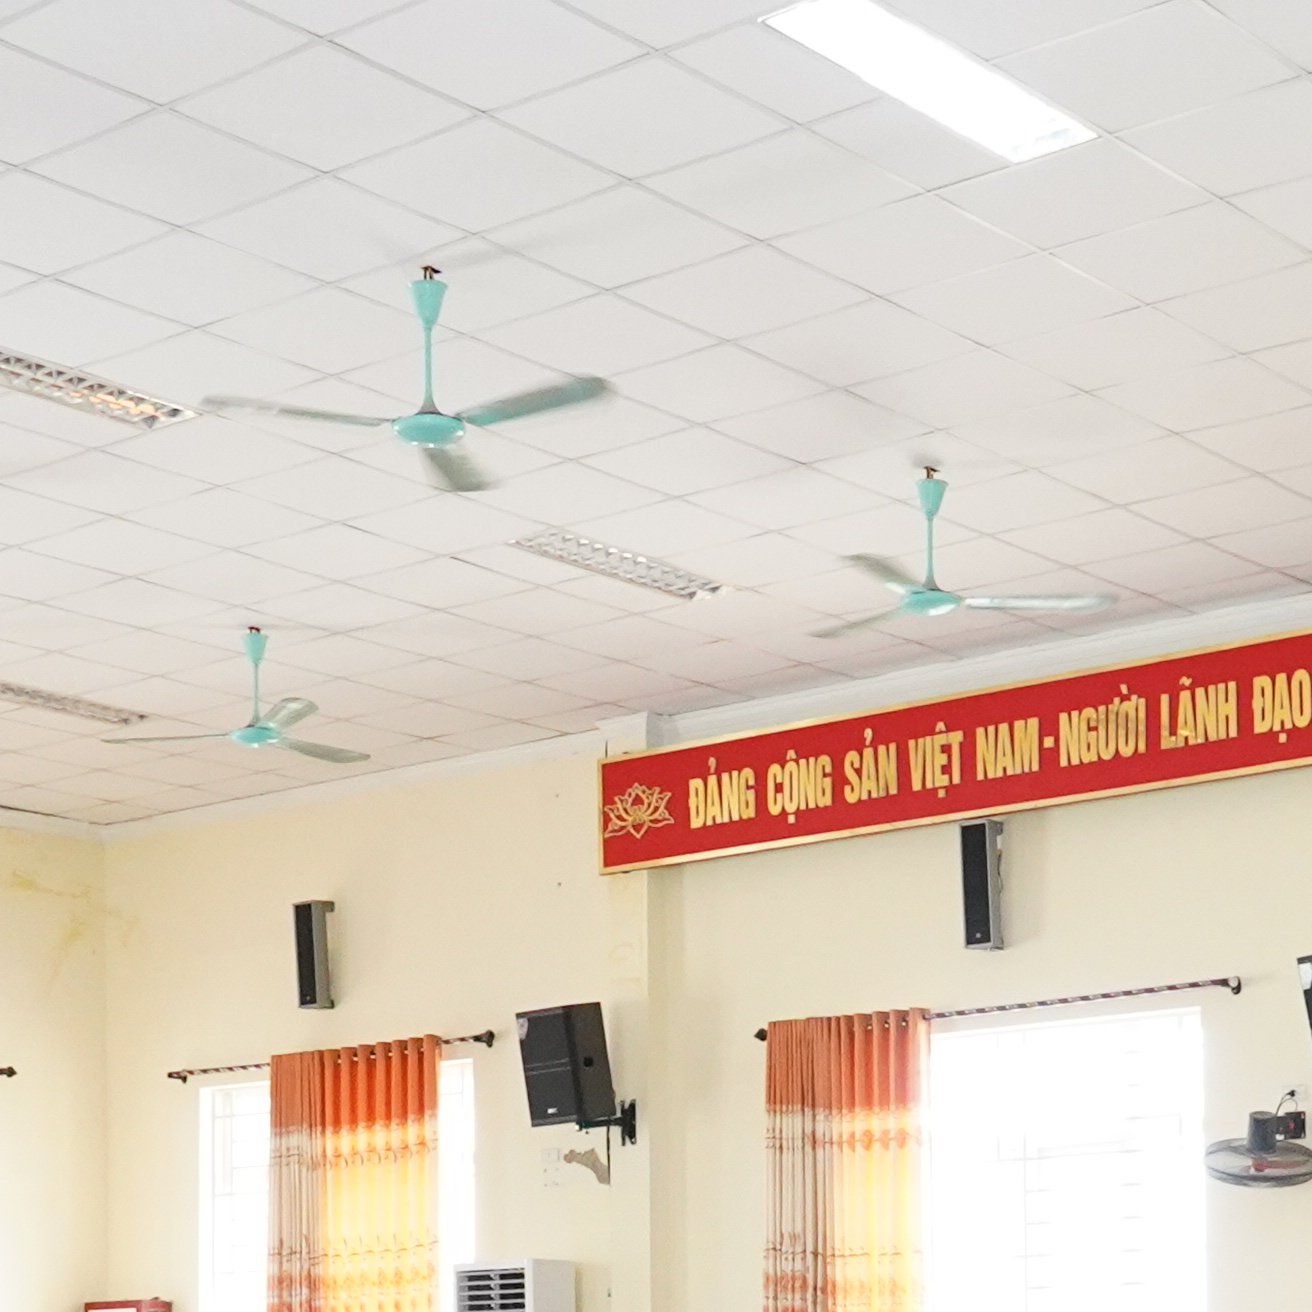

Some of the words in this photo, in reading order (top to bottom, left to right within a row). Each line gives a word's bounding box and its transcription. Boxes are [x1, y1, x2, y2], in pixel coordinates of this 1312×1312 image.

[688, 757, 756, 829] ĐẢNG
[767, 749, 833, 824] CỘNG
[843, 727, 898, 804] SẢN
[907, 721, 964, 798] VIỆT
[975, 716, 1040, 781] NAM
[1160, 676, 1238, 750] LÃNH
